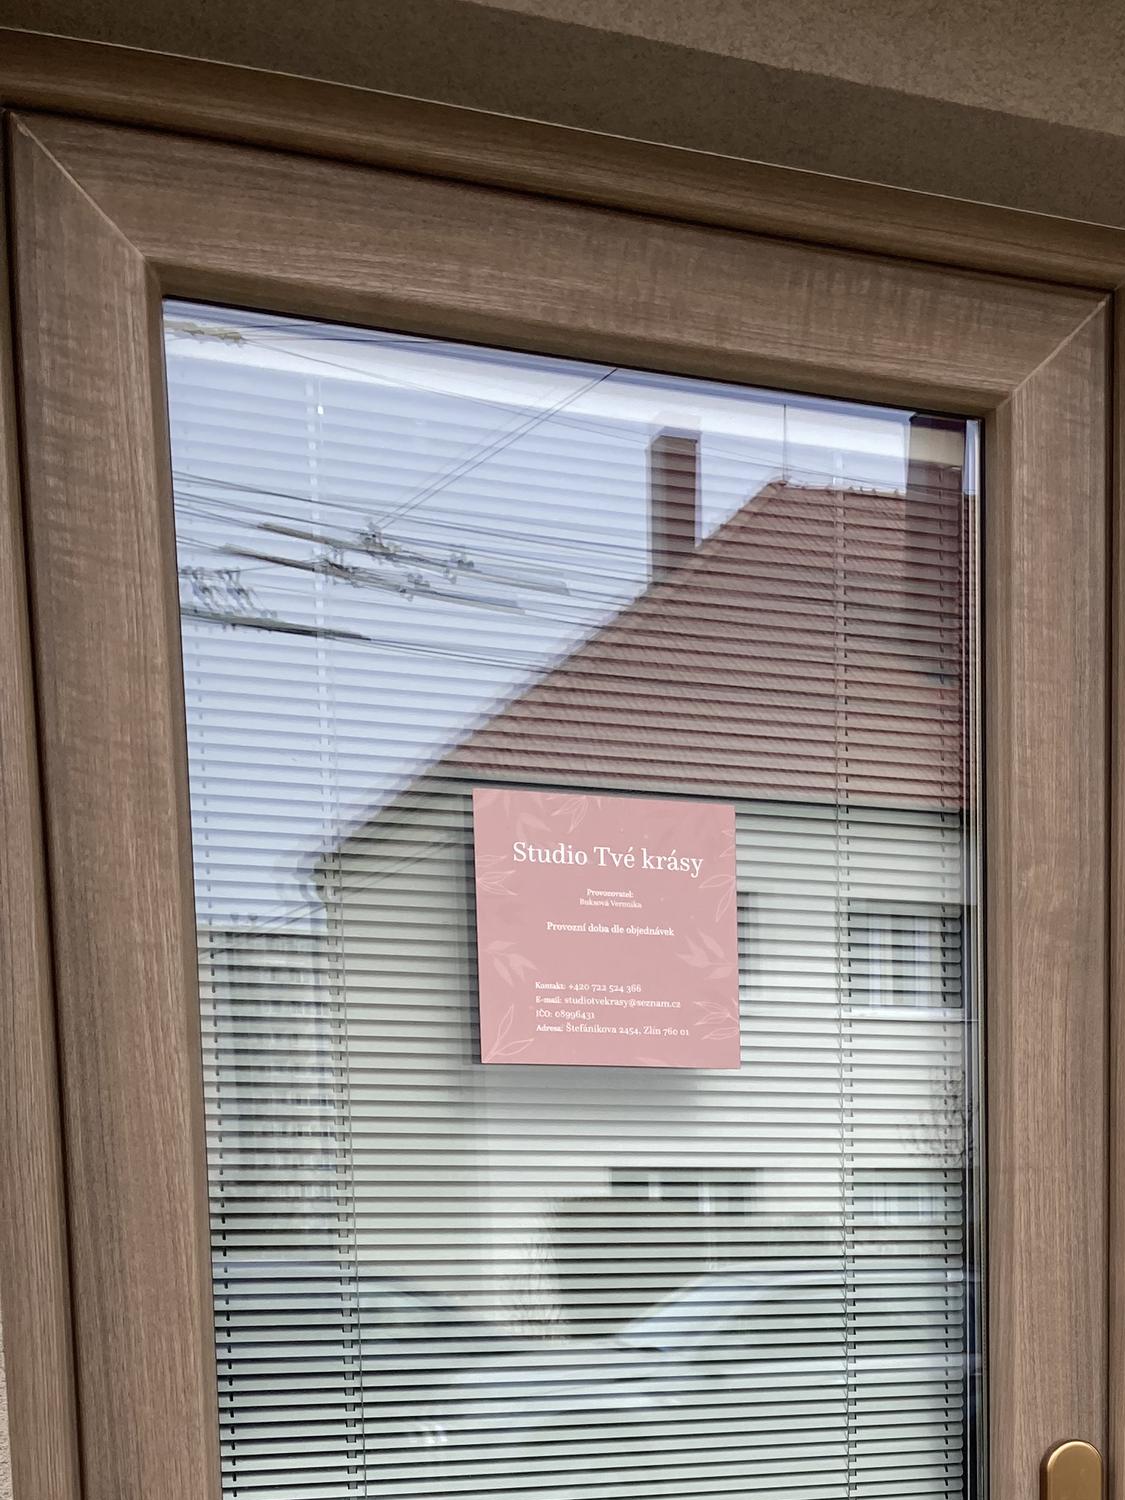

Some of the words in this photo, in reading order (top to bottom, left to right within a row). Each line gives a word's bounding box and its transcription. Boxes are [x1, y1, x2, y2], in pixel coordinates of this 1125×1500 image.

[513, 841, 588, 866] Studio
[593, 846, 635, 870] Tvé
[641, 848, 704, 878] krásy
[546, 921, 587, 933] Provozní
[588, 923, 610, 933] doba
[611, 924, 625, 934] dle
[626, 925, 675, 936] objednávek
[568, 984, 590, 992] +420
[591, 984, 607, 993] 722
[609, 984, 624, 993] 524
[626, 984, 642, 993] 366
[535, 996, 562, 1004] E-mail:
[564, 996, 681, 1009] studiotvekrasy@seznam.cz
[663, 1028, 678, 1037] 760
